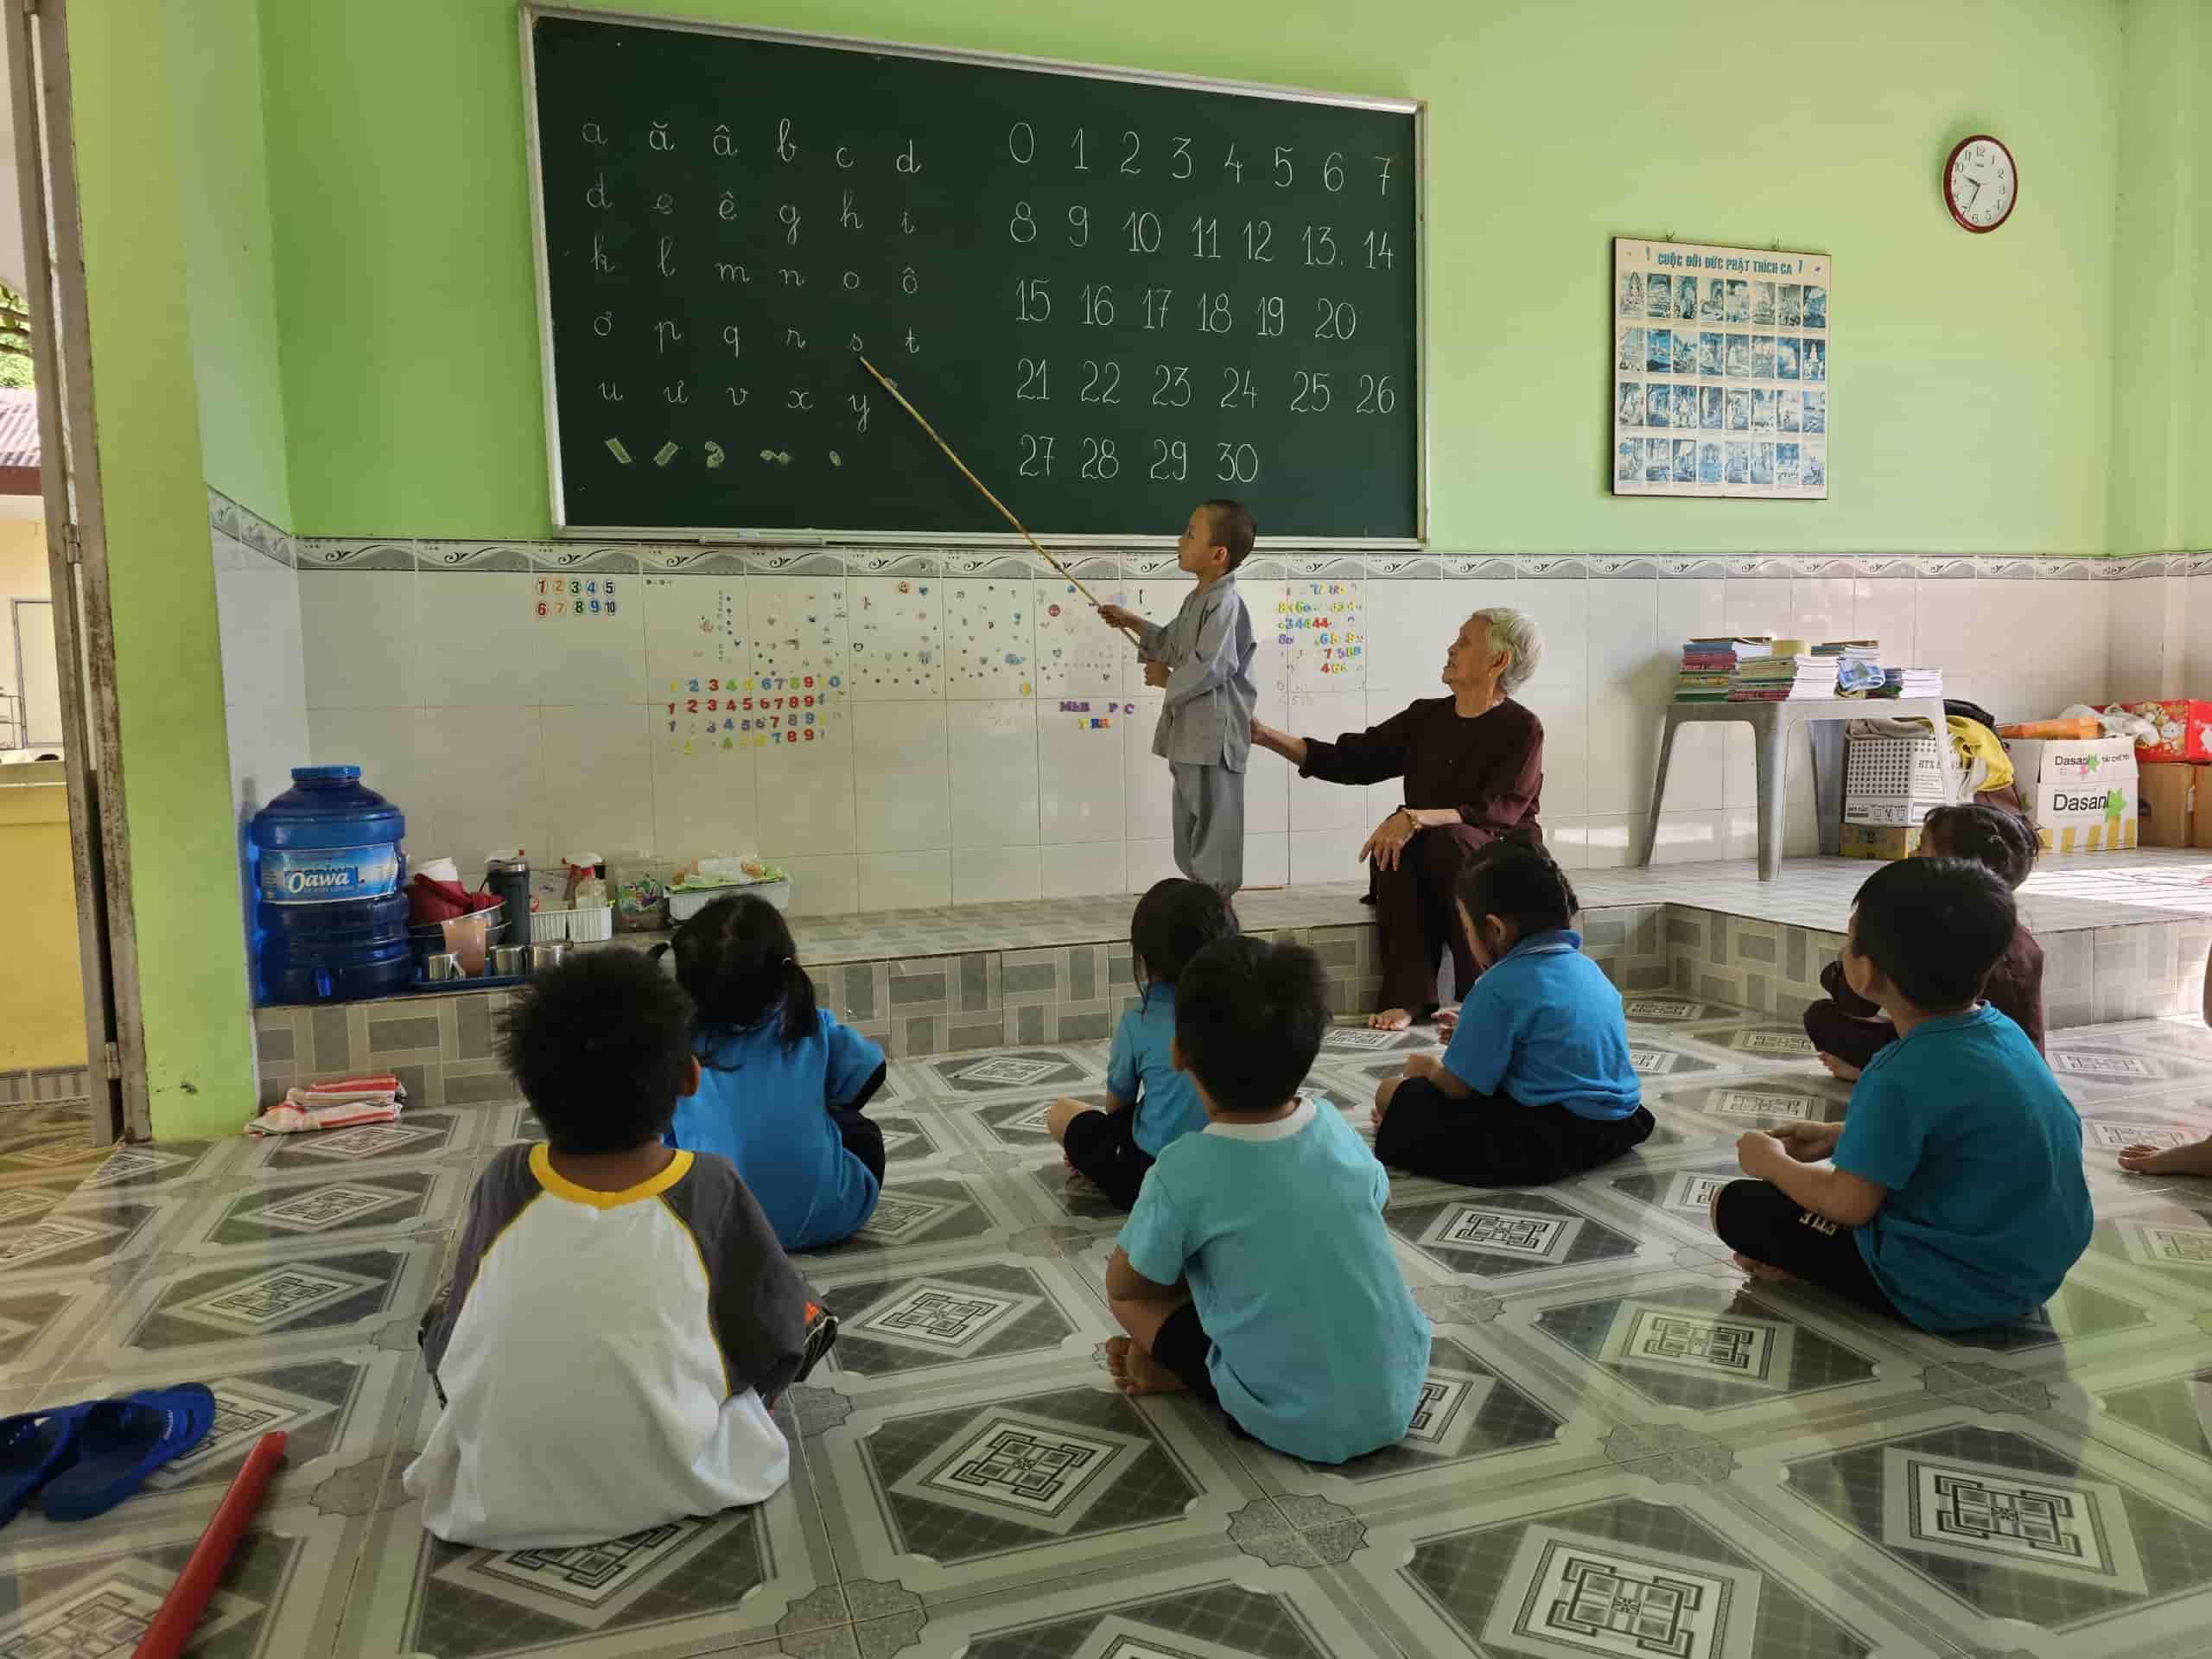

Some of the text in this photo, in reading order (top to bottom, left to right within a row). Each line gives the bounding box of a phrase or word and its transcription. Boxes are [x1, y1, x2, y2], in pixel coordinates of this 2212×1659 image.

[582, 118, 921, 174] a ă â b c d
[1009, 123, 1391, 195] 0 1 2 3 4 5 6 7
[718, 191, 738, 220] ê
[779, 205, 801, 245] g
[840, 188, 863, 229] h
[900, 211, 917, 234] i
[1010, 201, 1394, 270] 8 9 10 11 12 13 14
[658, 237, 677, 277] l
[714, 262, 751, 283] m
[779, 269, 805, 286] n
[843, 271, 859, 289] o
[901, 267, 918, 294] ô
[1015, 279, 1357, 340] 15 16 17 18 19 20
[723, 325, 740, 358] q
[905, 327, 920, 353] t
[597, 382, 624, 402] u
[726, 387, 749, 406] v
[787, 390, 814, 410] x
[848, 393, 870, 431] y
[1016, 359, 1395, 414] 21 22 23 24 25 26
[1019, 435, 1258, 483] 27 28 29 30
[538, 581, 545, 594] 1
[571, 582, 579, 594] 3
[588, 582, 594, 593] 4
[606, 582, 613, 594] 5
[538, 603, 546, 615] 6
[575, 601, 582, 613] 8
[591, 601, 599, 613] 9
[607, 601, 615, 613] 10
[668, 702, 675, 715] 1
[688, 699, 698, 714] 2
[707, 699, 717, 711] 3
[726, 699, 737, 711] 4
[742, 698, 753, 710] 5
[760, 698, 770, 709] 6
[774, 698, 784, 709] 7
[690, 679, 698, 691] 2
[709, 679, 719, 691] 3
[761, 677, 772, 690] 6
[774, 677, 786, 690] 7
[804, 677, 813, 688] 9
[668, 720, 676, 733] 1
[769, 716, 780, 728] 7
[787, 714, 798, 726] 8
